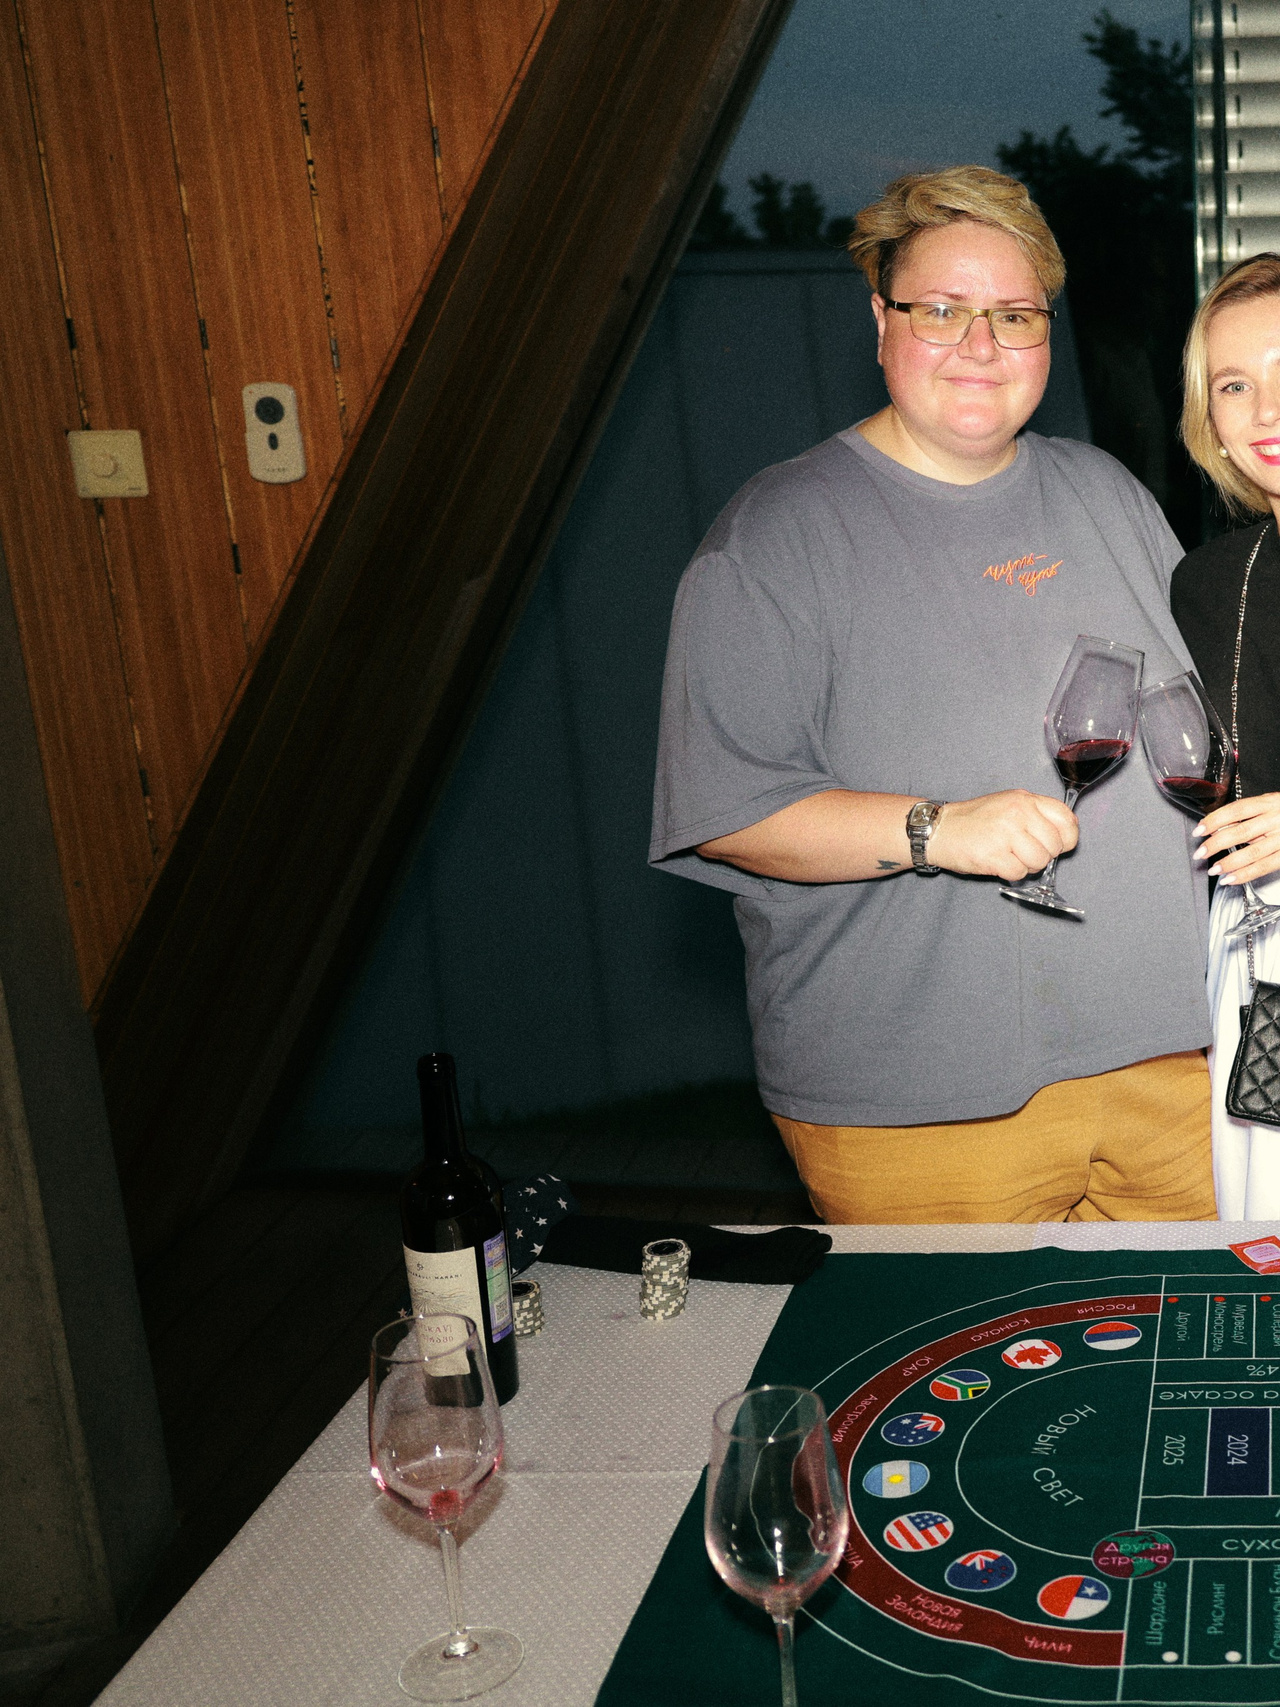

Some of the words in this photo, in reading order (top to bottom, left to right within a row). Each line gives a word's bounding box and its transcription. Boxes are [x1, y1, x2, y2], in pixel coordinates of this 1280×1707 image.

[1077, 1303, 1136, 1313] Россия
[970, 1317, 1031, 1342] Канада
[1175, 1311, 1192, 1342] Другой
[1212, 1301, 1227, 1353] Монастрель
[1231, 1303, 1248, 1346] Мурведр/
[902, 1355, 935, 1378] ЮАР
[1159, 1390, 1255, 1401] осадке
[832, 1394, 878, 1443] Австралия
[1031, 1404, 1097, 1456] НОВЫЙ
[1162, 1434, 1186, 1466] 2025
[1226, 1434, 1249, 1466] 2024
[1033, 1467, 1084, 1507] СВЕТ
[1098, 1554, 1168, 1565] страна
[1104, 1542, 1170, 1554] Другая
[885, 1594, 964, 1633] Зеландия
[912, 1593, 963, 1619] Новая
[1145, 1580, 1168, 1646] Шардоне
[1207, 1582, 1225, 1635] Рислинг
[1024, 1636, 1073, 1653] Чили
